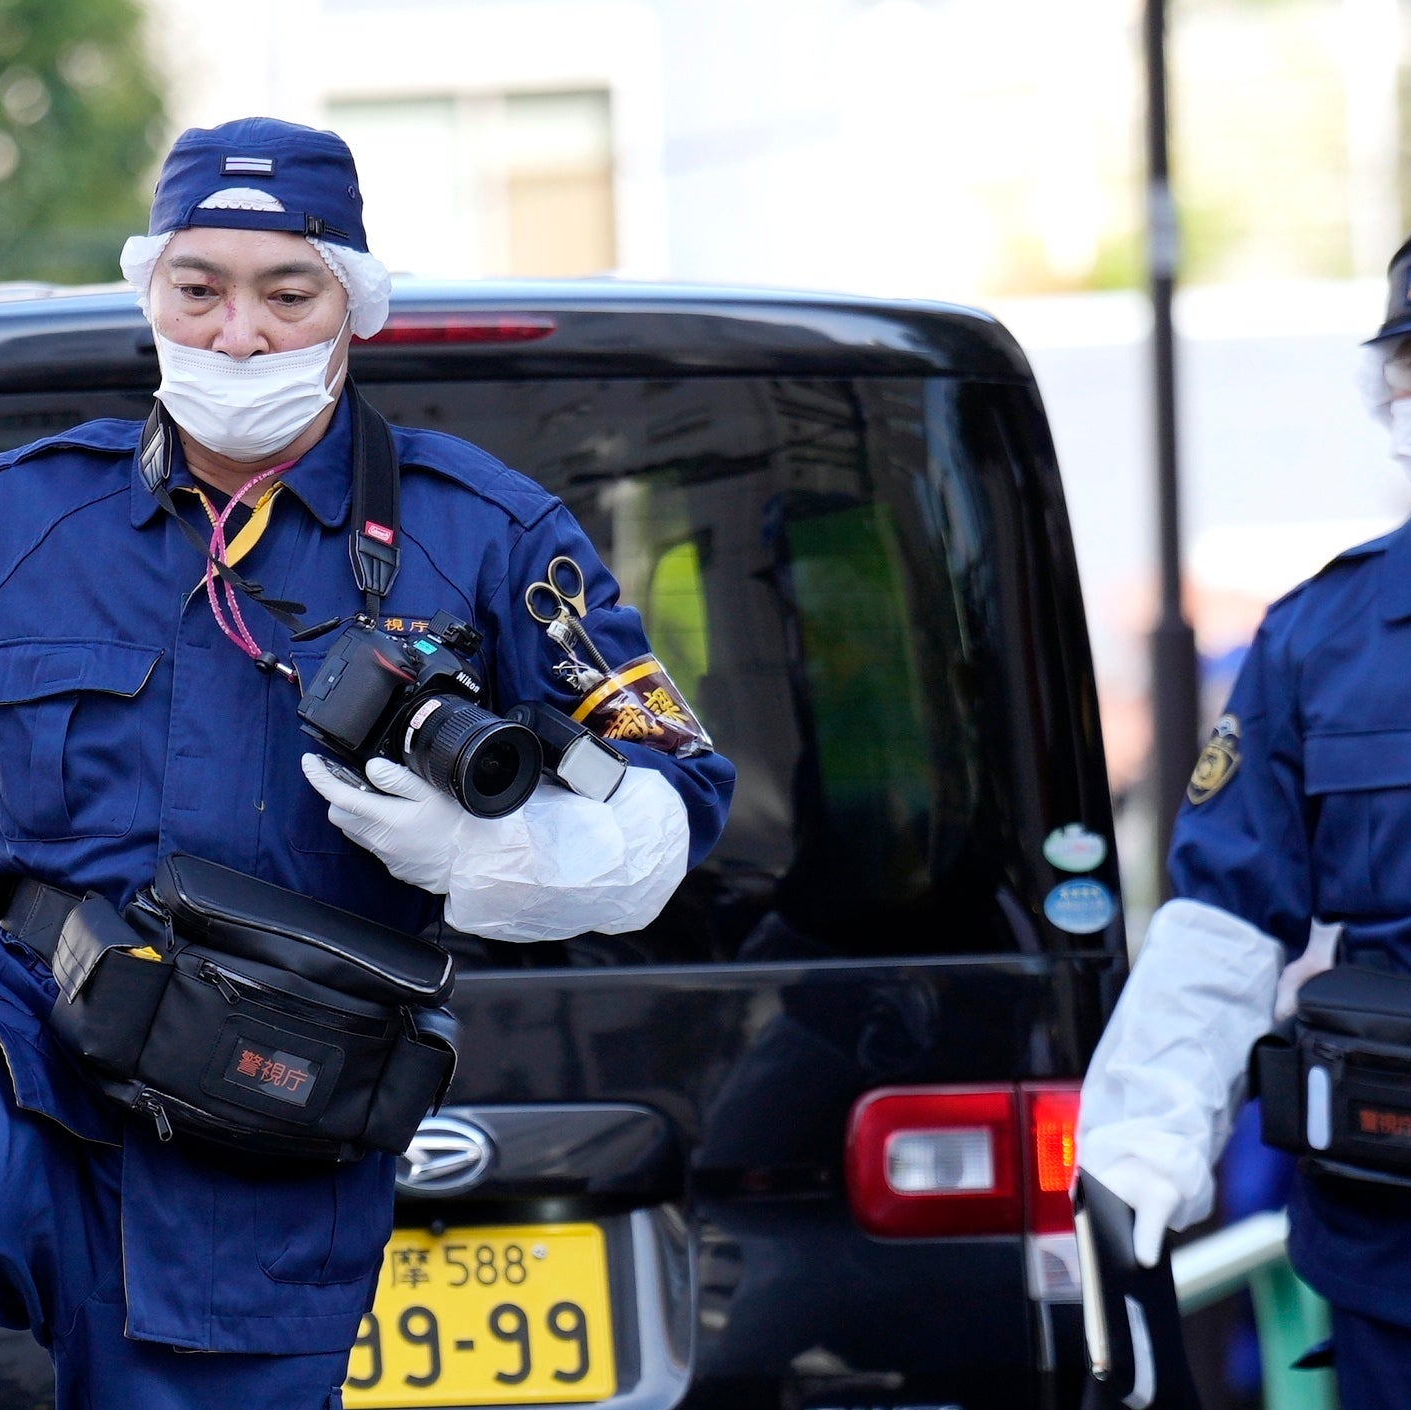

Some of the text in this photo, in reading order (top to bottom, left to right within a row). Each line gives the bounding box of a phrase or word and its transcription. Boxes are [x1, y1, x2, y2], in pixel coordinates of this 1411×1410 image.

[384, 618, 430, 633] 視庁
[456, 671, 481, 694] Nikon
[236, 1049, 309, 1093] 警視庁
[391, 1244, 528, 1289] 摩 588
